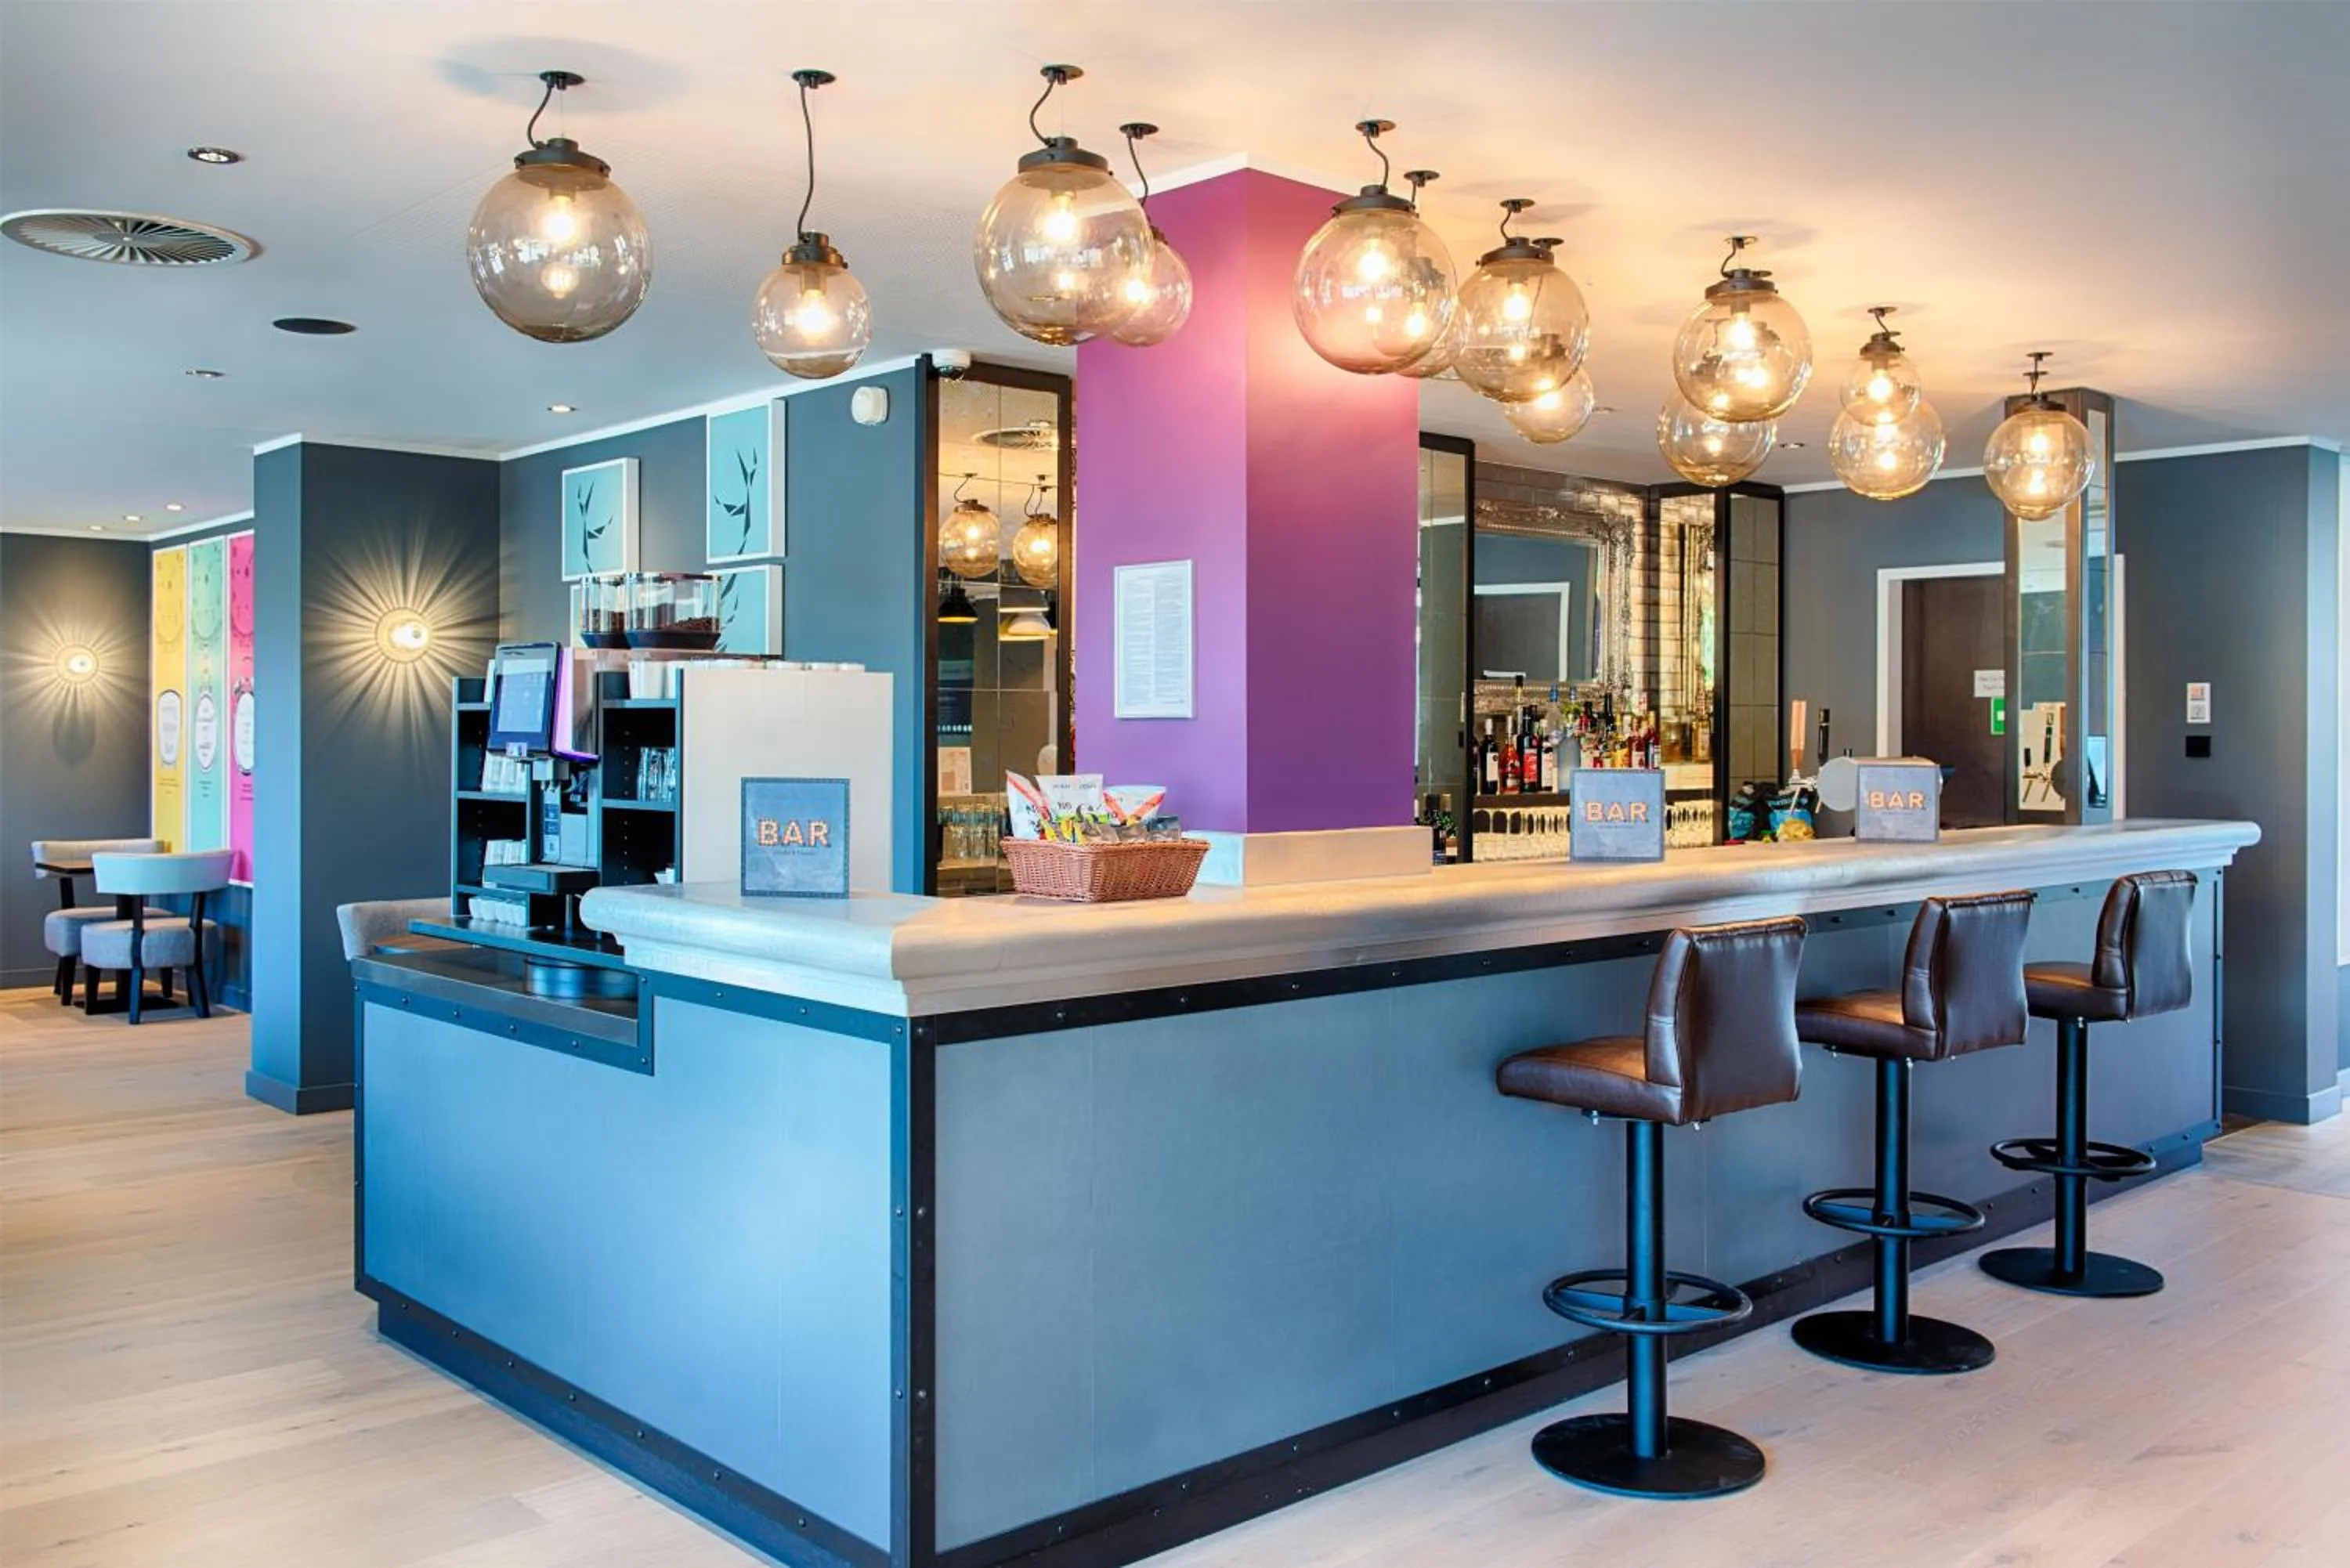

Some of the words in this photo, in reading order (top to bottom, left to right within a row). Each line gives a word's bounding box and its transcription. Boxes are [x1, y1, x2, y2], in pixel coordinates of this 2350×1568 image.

[1868, 790, 1926, 810] BAR
[1585, 801, 1649, 823] BAR
[757, 818, 831, 847] BAR
